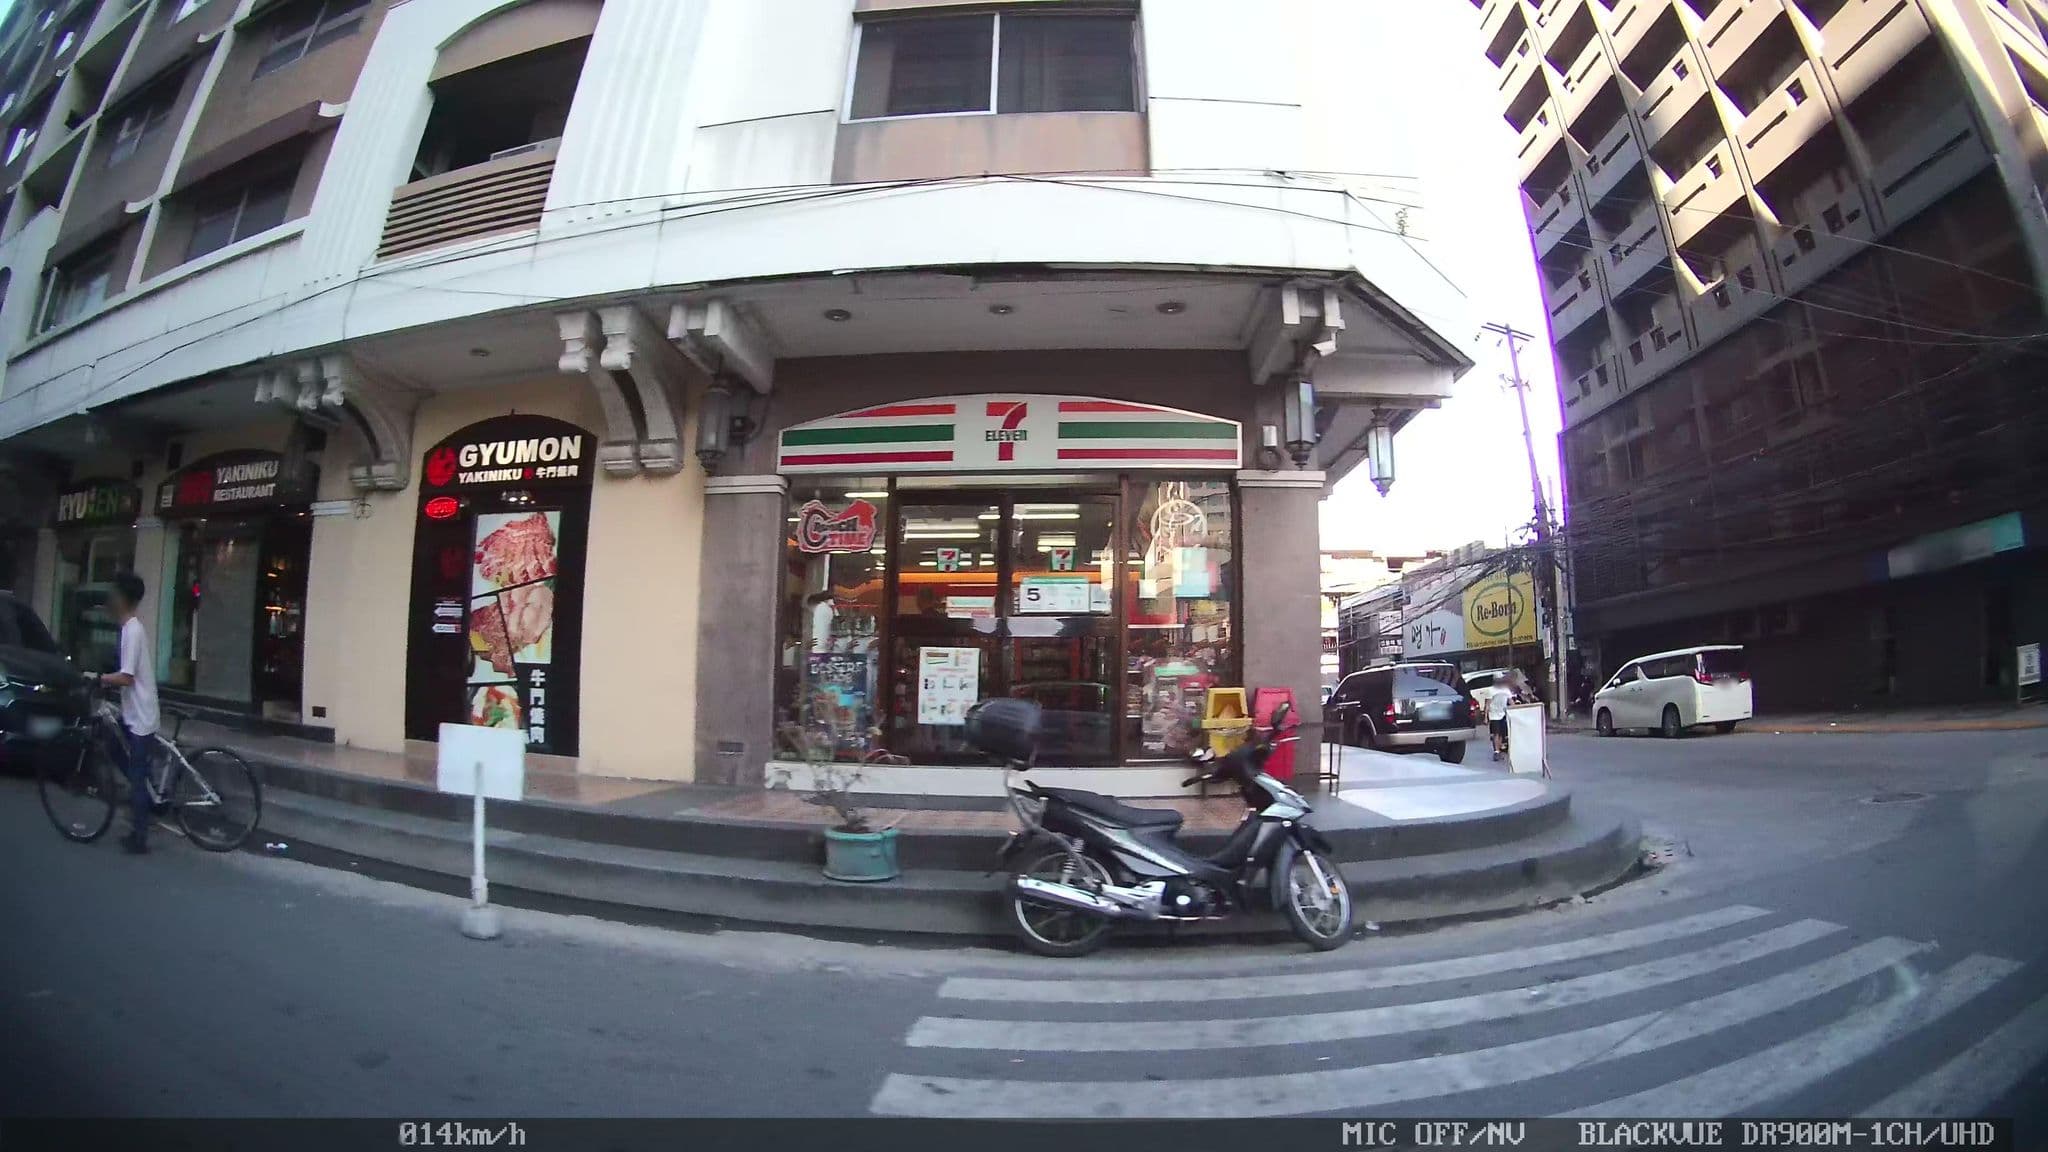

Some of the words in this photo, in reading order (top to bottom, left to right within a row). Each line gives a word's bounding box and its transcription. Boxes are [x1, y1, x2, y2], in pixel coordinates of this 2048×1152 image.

[458, 434, 583, 468] GYUMON
[216, 459, 280, 485] YAKINIKU
[458, 467, 523, 484] YAKINIKU
[213, 483, 277, 502] RESTAURANT
[1026, 587, 1041, 602] 5
